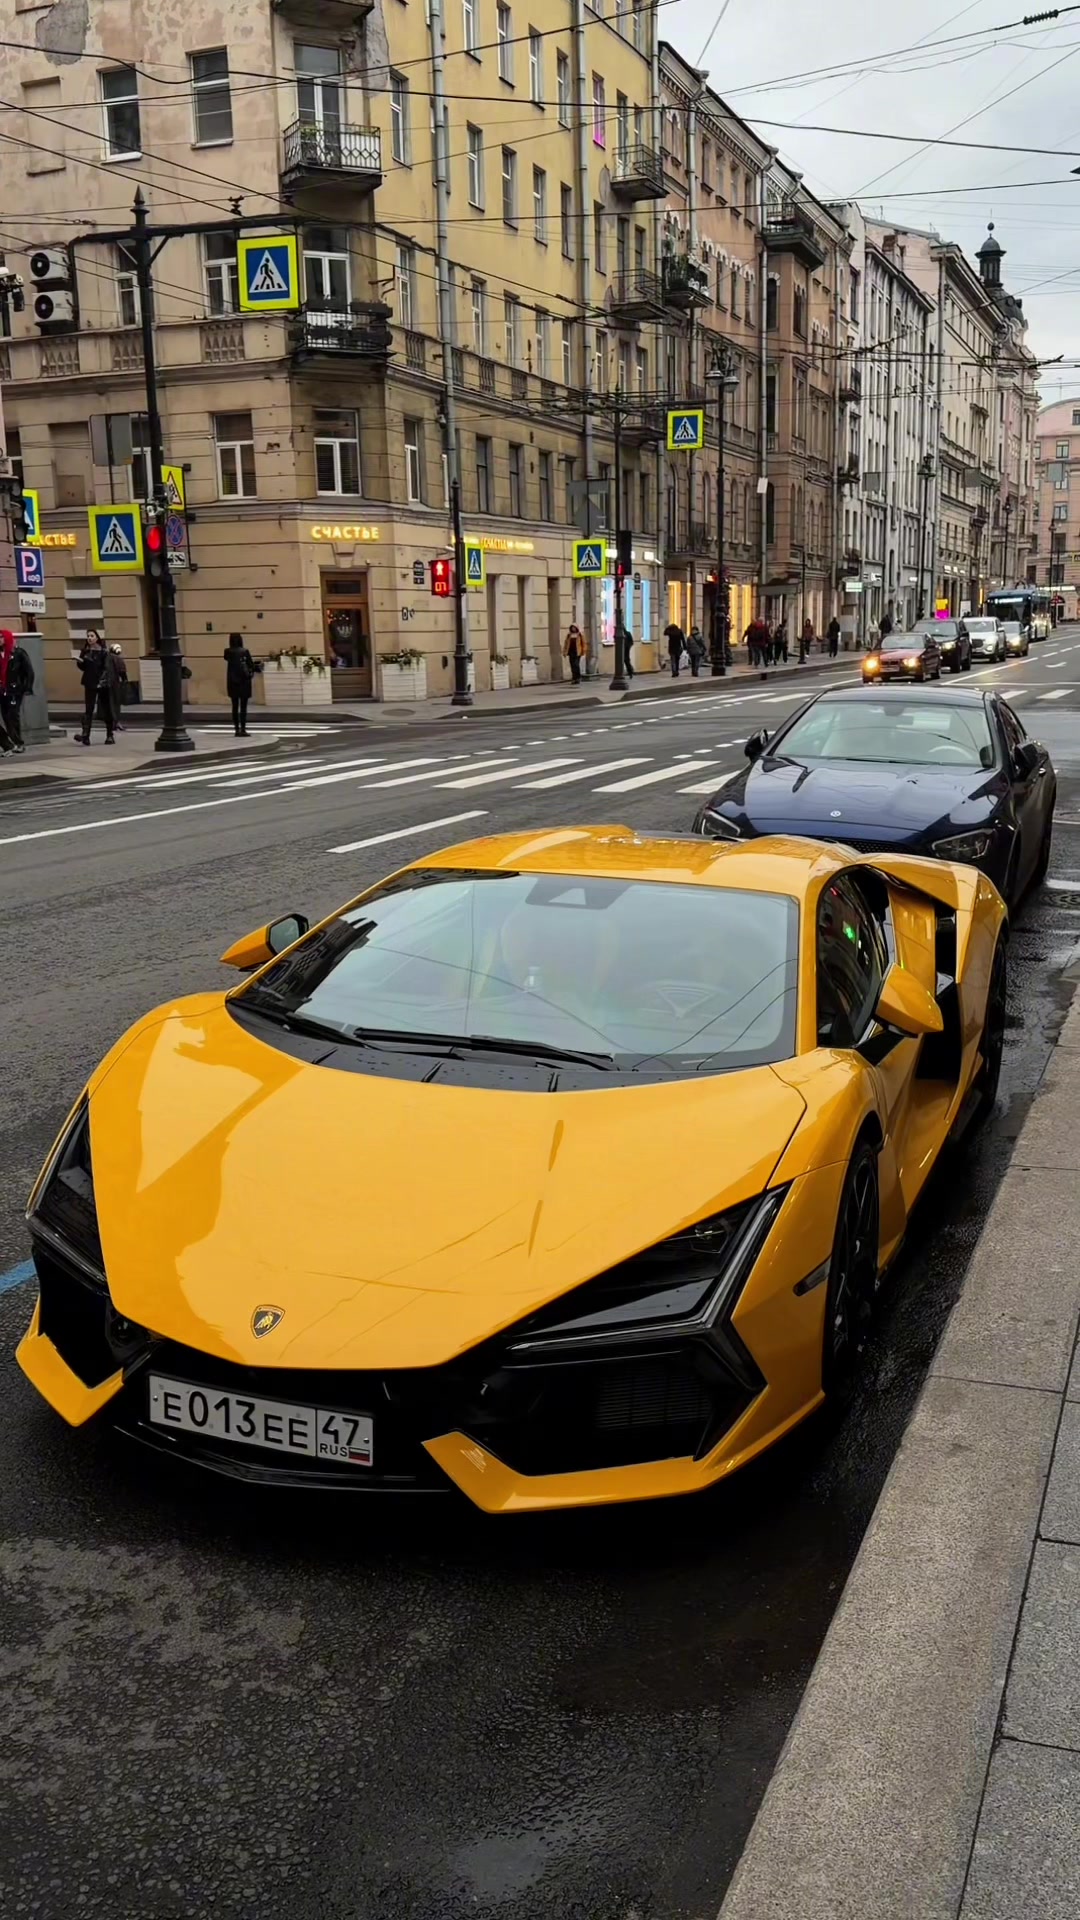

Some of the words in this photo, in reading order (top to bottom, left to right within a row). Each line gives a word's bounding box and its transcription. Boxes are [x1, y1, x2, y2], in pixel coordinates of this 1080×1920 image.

[311, 526, 379, 539] СЧАСТЬЕ
[322, 1415, 359, 1446] 47
[319, 1443, 348, 1457] RUS
